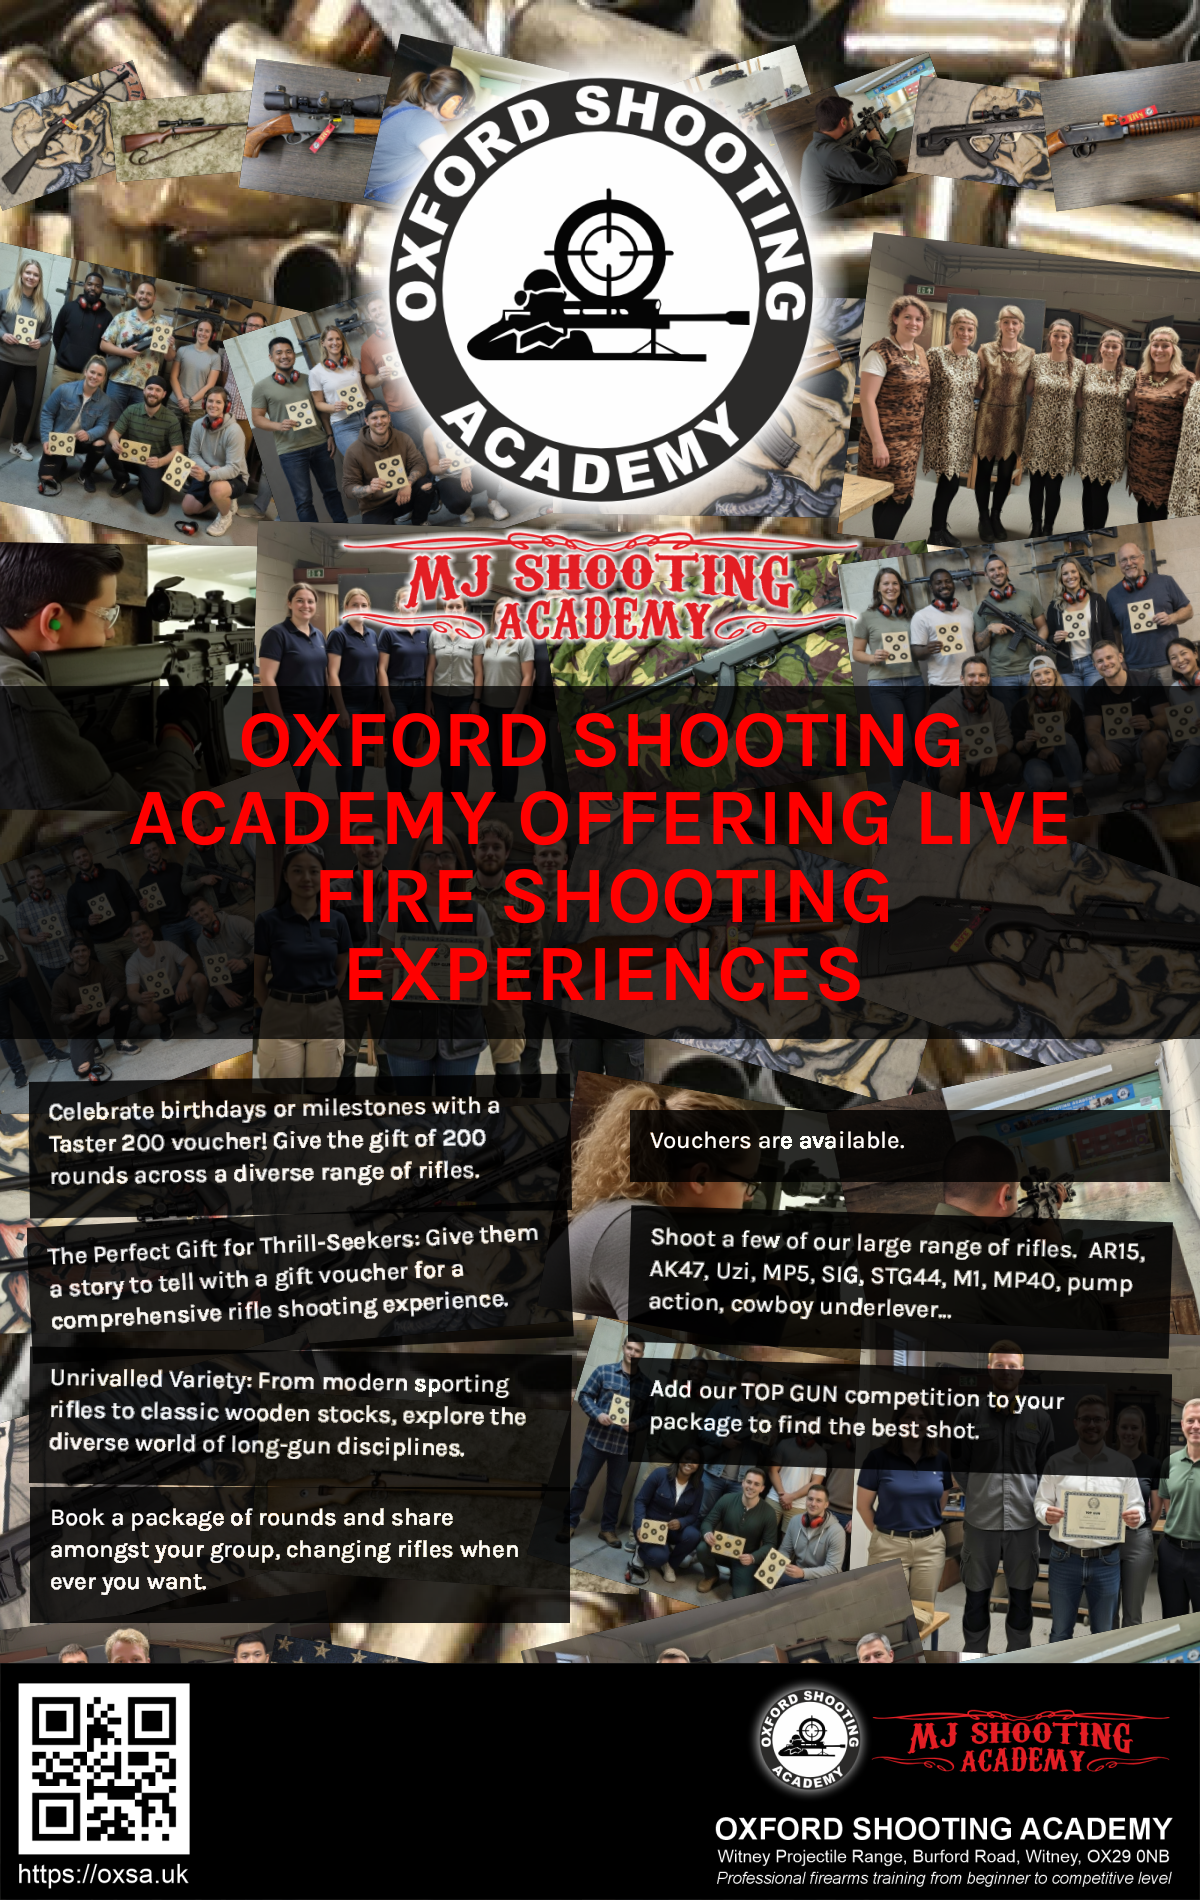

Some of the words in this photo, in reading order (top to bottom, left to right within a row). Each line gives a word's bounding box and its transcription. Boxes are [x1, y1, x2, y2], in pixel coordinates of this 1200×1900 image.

[396, 98, 551, 322] OXFORD
[574, 84, 807, 322] SHOOTING
[440, 400, 741, 494] ACADEMY
[404, 554, 492, 608] MJ
[513, 552, 794, 608] SHOOTING
[495, 596, 711, 640] ACADEMY
[241, 712, 546, 768] OXFORD
[575, 712, 960, 768] SHOOTING
[129, 790, 497, 846] ACADEMY
[520, 790, 888, 846] OFFERING
[921, 791, 1067, 845] LIVE
[320, 869, 473, 923] FIRE
[503, 868, 889, 924] SHOOTING
[349, 946, 861, 1002] EXPERIENCES
[49, 1102, 154, 1121] Celebrate
[162, 1101, 266, 1123] birthdays
[274, 1104, 295, 1117] or
[303, 1099, 425, 1117] milestones
[433, 1097, 480, 1115] with
[488, 1101, 499, 1114] a
[49, 1136, 116, 1153] Taster
[122, 1134, 164, 1151] 200
[172, 1132, 267, 1151] voucher!
[274, 1131, 321, 1149] Give
[327, 1130, 363, 1149] the
[369, 1129, 408, 1153] gift
[415, 1129, 436, 1148] of
[443, 1129, 485, 1147] 200
[651, 1132, 750, 1149] Vouchers
[759, 1136, 792, 1149] are
[800, 1131, 904, 1149] available.
[51, 1166, 128, 1185] rounds
[135, 1170, 206, 1184] across
[215, 1169, 226, 1183] a
[234, 1164, 314, 1183] diverse
[322, 1165, 384, 1185] range
[391, 1161, 412, 1180] of
[420, 1161, 479, 1179] rifles.
[47, 1247, 87, 1265] The
[95, 1243, 170, 1262] Perfect
[177, 1240, 217, 1260] Gift
[224, 1238, 254, 1256] for
[260, 1231, 420, 1254] Thrill-Seekers:
[426, 1228, 473, 1247] Give
[479, 1225, 538, 1245] them
[651, 1228, 715, 1247] Shoot
[723, 1235, 733, 1247] a
[742, 1230, 780, 1249] few
[787, 1232, 808, 1250] of
[814, 1237, 850, 1251] our
[858, 1234, 911, 1258] large
[920, 1240, 981, 1260] range
[988, 1238, 1009, 1256] of
[1017, 1239, 1076, 1258] rifles.
[1089, 1243, 1145, 1262] AR15,
[50, 1284, 62, 1298] a
[70, 1277, 123, 1299] story
[129, 1277, 153, 1294] to
[159, 1272, 193, 1292] tell
[200, 1270, 248, 1289] with
[256, 1274, 267, 1287] a
[276, 1267, 313, 1291] gift
[319, 1263, 408, 1284] voucher
[415, 1261, 445, 1279] for
[452, 1264, 463, 1277] a
[650, 1261, 708, 1281] AK47,
[717, 1262, 755, 1282] Uzi,
[763, 1264, 815, 1284] MP5,
[822, 1266, 864, 1286] SIG,
[871, 1267, 946, 1288] STG44,
[954, 1270, 986, 1290] M1,
[994, 1272, 1060, 1292] MP40,
[1068, 1278, 1132, 1297] pump
[51, 1305, 222, 1332] comprehensive
[229, 1301, 271, 1320] rifle
[278, 1296, 378, 1319] shooting
[383, 1292, 508, 1316] experience.
[649, 1292, 723, 1313] action,
[732, 1296, 813, 1319] cowboy
[821, 1298, 951, 1319] underlever...
[51, 1369, 162, 1388] Unrivalled
[170, 1371, 252, 1394] Variety:
[259, 1372, 314, 1391] From
[323, 1374, 407, 1392] modern
[415, 1376, 509, 1398] sporting
[651, 1380, 690, 1398] Add
[700, 1386, 736, 1400] our
[741, 1383, 784, 1401] TOP
[790, 1385, 836, 1403] GUN
[845, 1388, 979, 1411] competition
[987, 1391, 1008, 1408] to
[1015, 1396, 1064, 1414] your
[51, 1400, 105, 1419] rifles
[112, 1403, 135, 1420] to
[141, 1402, 218, 1421] classic
[225, 1404, 309, 1423] wooden
[318, 1405, 396, 1425] stocks,
[403, 1406, 484, 1429] explore
[490, 1407, 526, 1426] the
[651, 1413, 742, 1437] package
[749, 1417, 771, 1434] to
[779, 1416, 820, 1435] find
[829, 1418, 865, 1436] the
[872, 1418, 919, 1438] best
[927, 1421, 979, 1439] shot.
[50, 1432, 128, 1451] diverse
[136, 1434, 195, 1452] world
[203, 1435, 225, 1453] of
[232, 1436, 330, 1459] long-gun
[338, 1437, 464, 1461] disciplines.
[51, 1508, 104, 1526] Book
[112, 1513, 123, 1526] a
[132, 1508, 224, 1531] package
[231, 1508, 253, 1526] of
[260, 1508, 336, 1526] rounds
[344, 1508, 384, 1526] and
[392, 1508, 453, 1526] share
[51, 1542, 149, 1563] amongst
[154, 1545, 204, 1563] your
[210, 1543, 280, 1563] group,
[287, 1540, 391, 1563] changing
[399, 1540, 453, 1558] rifles
[460, 1540, 518, 1558] when
[51, 1577, 96, 1590] ever
[101, 1577, 139, 1595] you
[147, 1574, 206, 1591] want.
[761, 1693, 798, 1748] OXFORD
[804, 1690, 860, 1748] SHOOTING
[907, 1722, 957, 1754] MJ
[971, 1721, 1133, 1754] SHOOTING
[961, 1747, 1085, 1772] ACADEMY
[772, 1765, 844, 1789] ACADEMY
[715, 1817, 844, 1841] OXFORD
[853, 1817, 1012, 1841] SHOOTING
[1020, 1817, 1172, 1841] ACADEMY
[717, 1849, 770, 1866] Witney
[776, 1849, 847, 1866] Projectile
[852, 1849, 907, 1866] Range,
[913, 1849, 969, 1863] Burford
[975, 1849, 1020, 1865] Road,
[1025, 1849, 1082, 1866] Witney,
[1087, 1849, 1131, 1863] OX29
[1136, 1849, 1170, 1863] 0NB
[18, 1863, 189, 1889] https://oxsa.uk
[717, 1872, 806, 1884] Professional
[809, 1872, 869, 1884] firearms
[872, 1872, 926, 1887] training
[930, 1872, 962, 1884] from
[967, 1872, 1031, 1887] beginner
[1035, 1872, 1048, 1884] to
[1052, 1872, 1134, 1887] competitive
[1138, 1872, 1172, 1884] level
